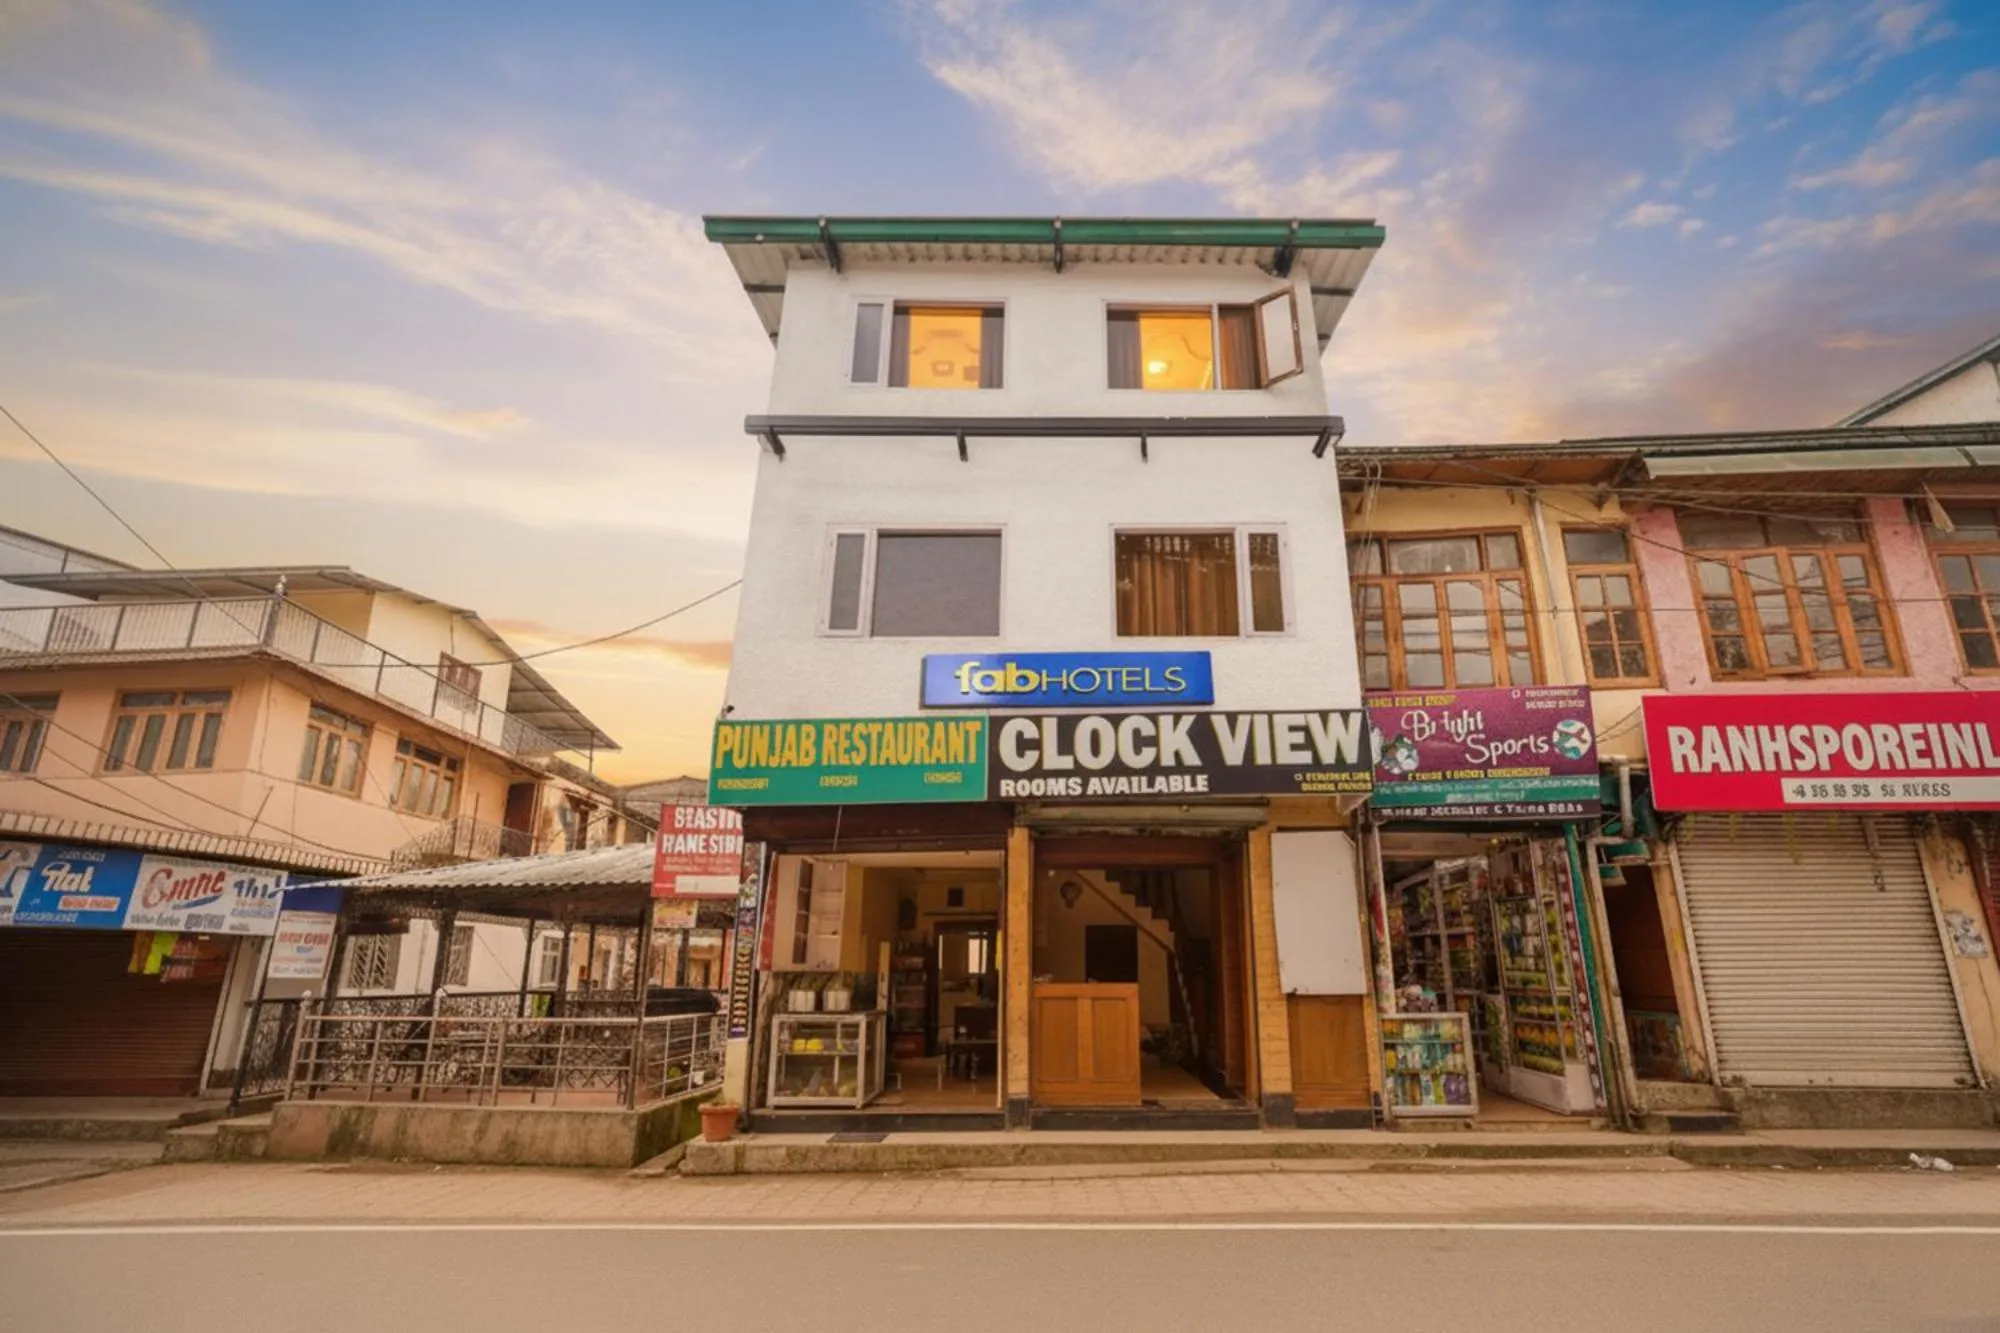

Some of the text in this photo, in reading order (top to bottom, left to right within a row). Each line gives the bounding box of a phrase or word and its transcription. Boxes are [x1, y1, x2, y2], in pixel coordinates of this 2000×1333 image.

[715, 720, 982, 769] PUNJAB RESTAURANT
[999, 711, 1362, 772] CLOCK VIEW
[1000, 774, 1209, 798] ROOMS AVAILABLE
